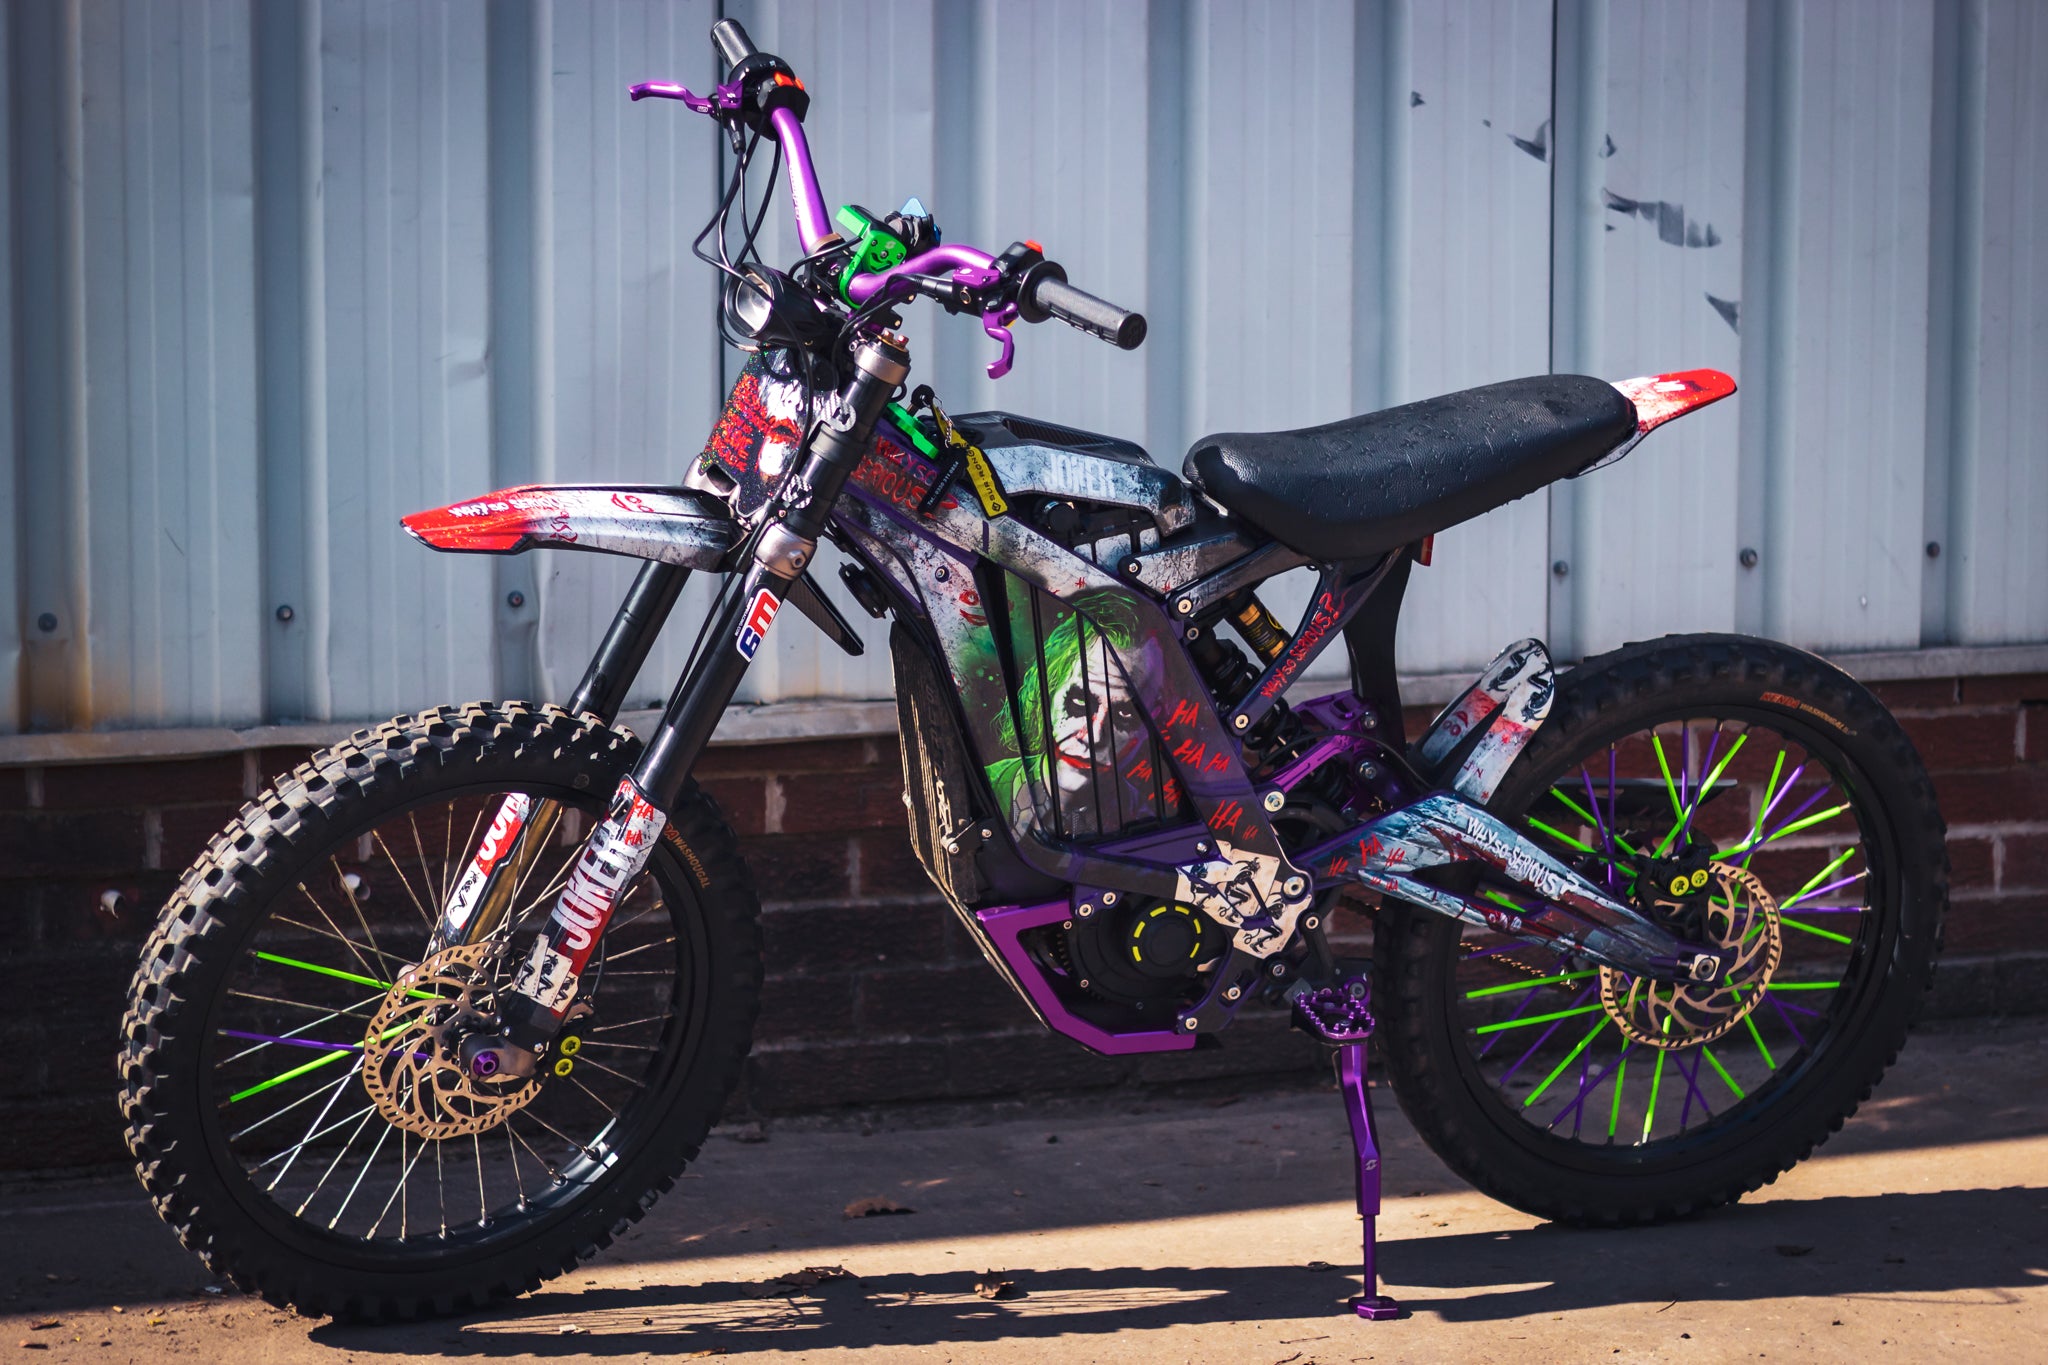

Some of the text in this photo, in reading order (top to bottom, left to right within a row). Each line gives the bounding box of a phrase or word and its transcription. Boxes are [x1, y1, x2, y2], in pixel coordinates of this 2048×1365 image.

[1042, 453, 1116, 498] JOKER
[1166, 699, 1199, 728] HA
[1173, 739, 1230, 773] HA HA
[1208, 799, 1243, 835] HA
[1467, 816, 1498, 850] WHY
[624, 829, 643, 846] HA
[673, 836, 711, 889] WASHOUGAL
[551, 823, 639, 950] JOKER
